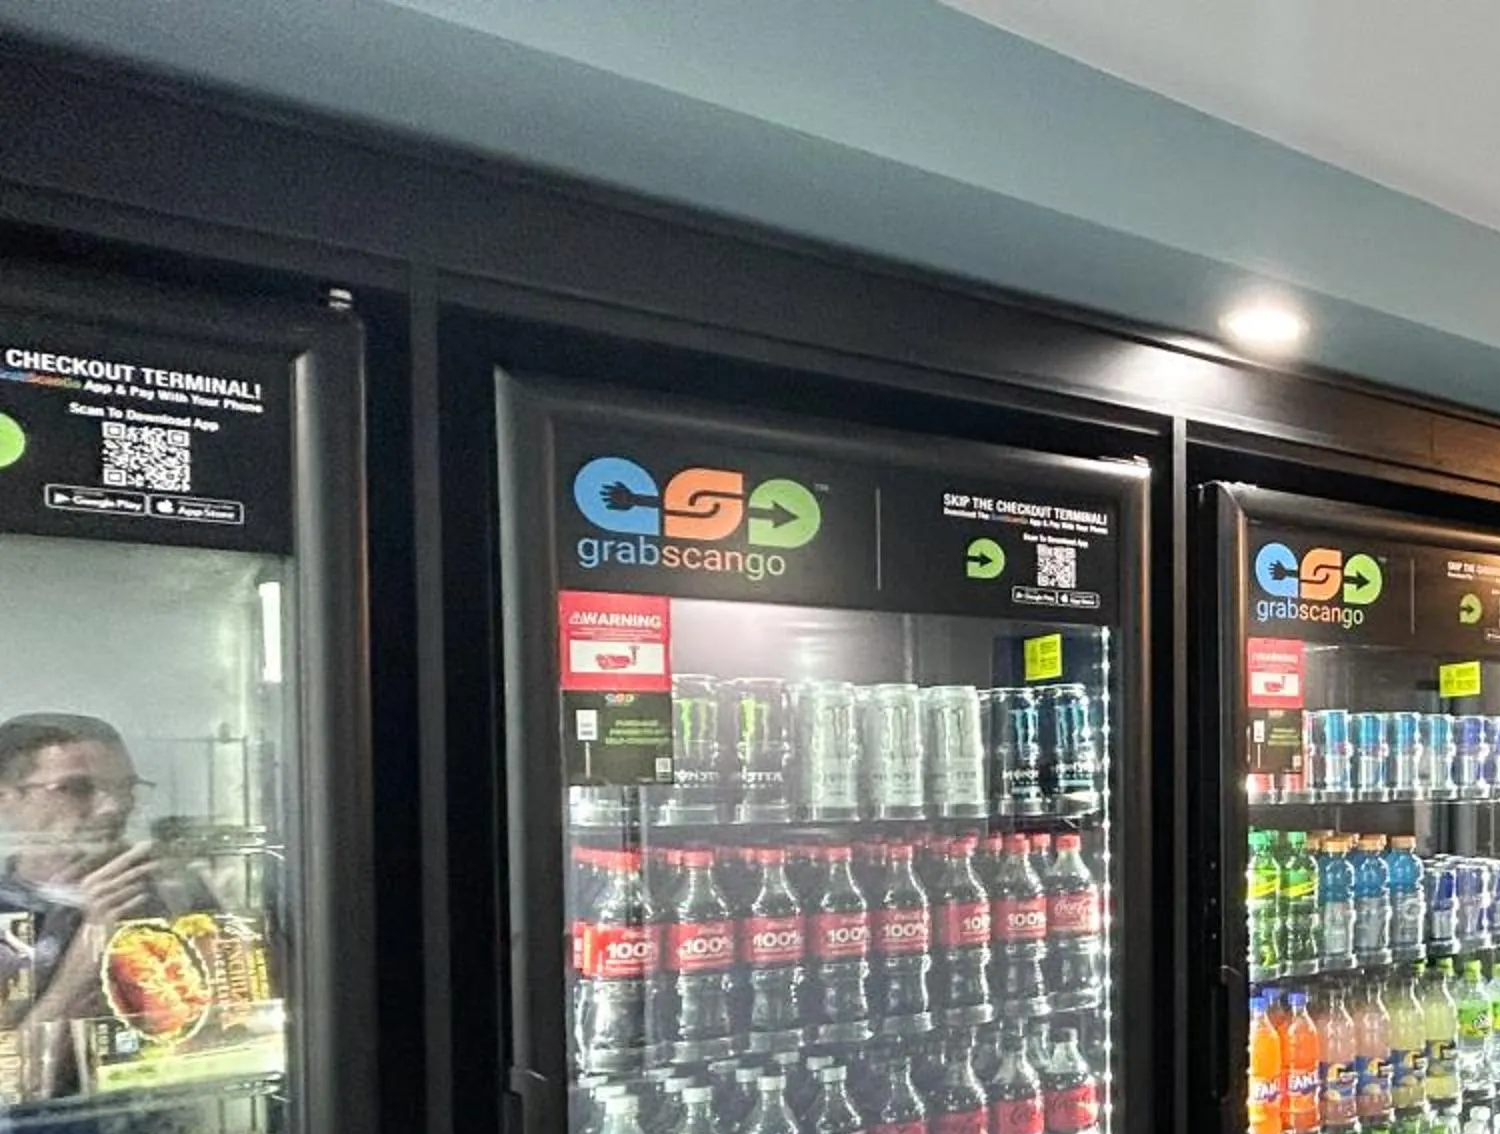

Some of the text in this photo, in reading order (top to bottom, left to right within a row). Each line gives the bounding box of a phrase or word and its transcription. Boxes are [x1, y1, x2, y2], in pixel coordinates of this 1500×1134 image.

[5, 349, 136, 382] CHECKOUT
[140, 368, 262, 400] TERMINAL!
[83, 381, 112, 396] App
[69, 402, 105, 416] Scan
[108, 407, 123, 419] To
[126, 409, 192, 427] Download
[943, 493, 971, 507] SKIP
[971, 497, 994, 511] THE
[577, 536, 787, 582] grabscango
[583, 611, 663, 630] WARNING
[1256, 597, 1364, 628] grabscango
